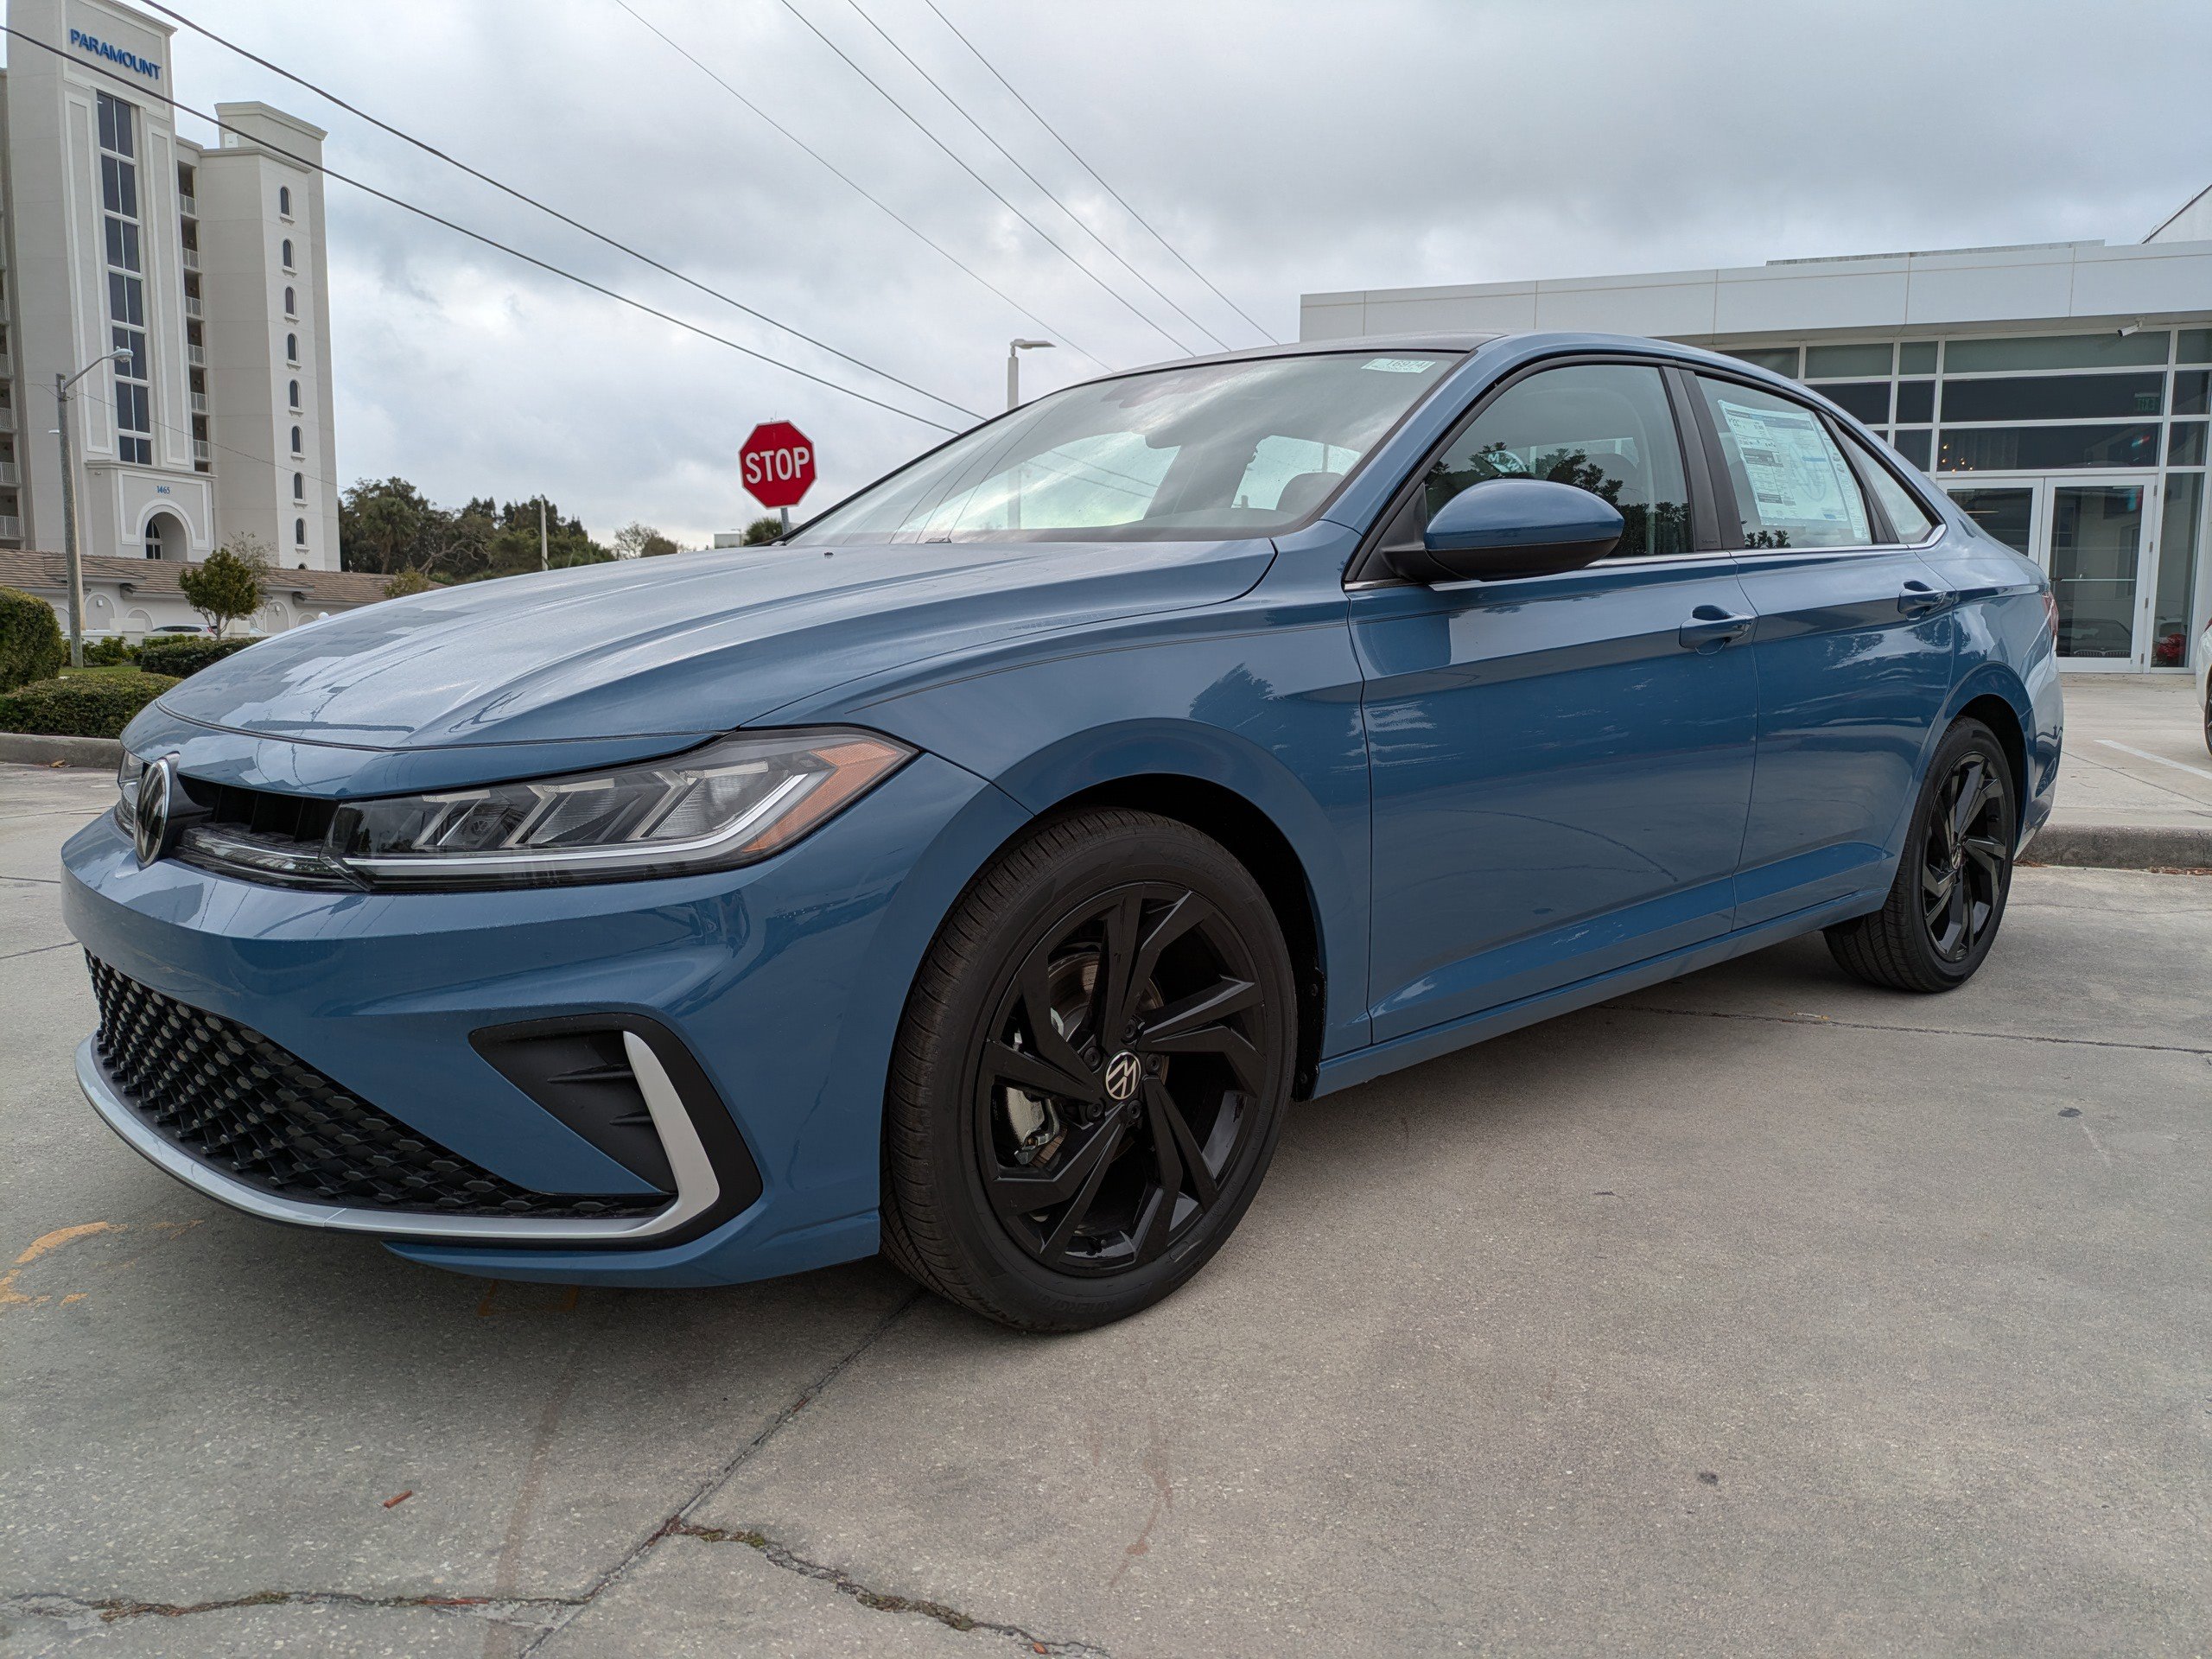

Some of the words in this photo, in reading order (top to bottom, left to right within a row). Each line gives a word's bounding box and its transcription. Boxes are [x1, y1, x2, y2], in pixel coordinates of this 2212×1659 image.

[70, 29, 162, 80] PARAMOUNT
[745, 446, 810, 485] STOP
[156, 485, 171, 494] 1465
